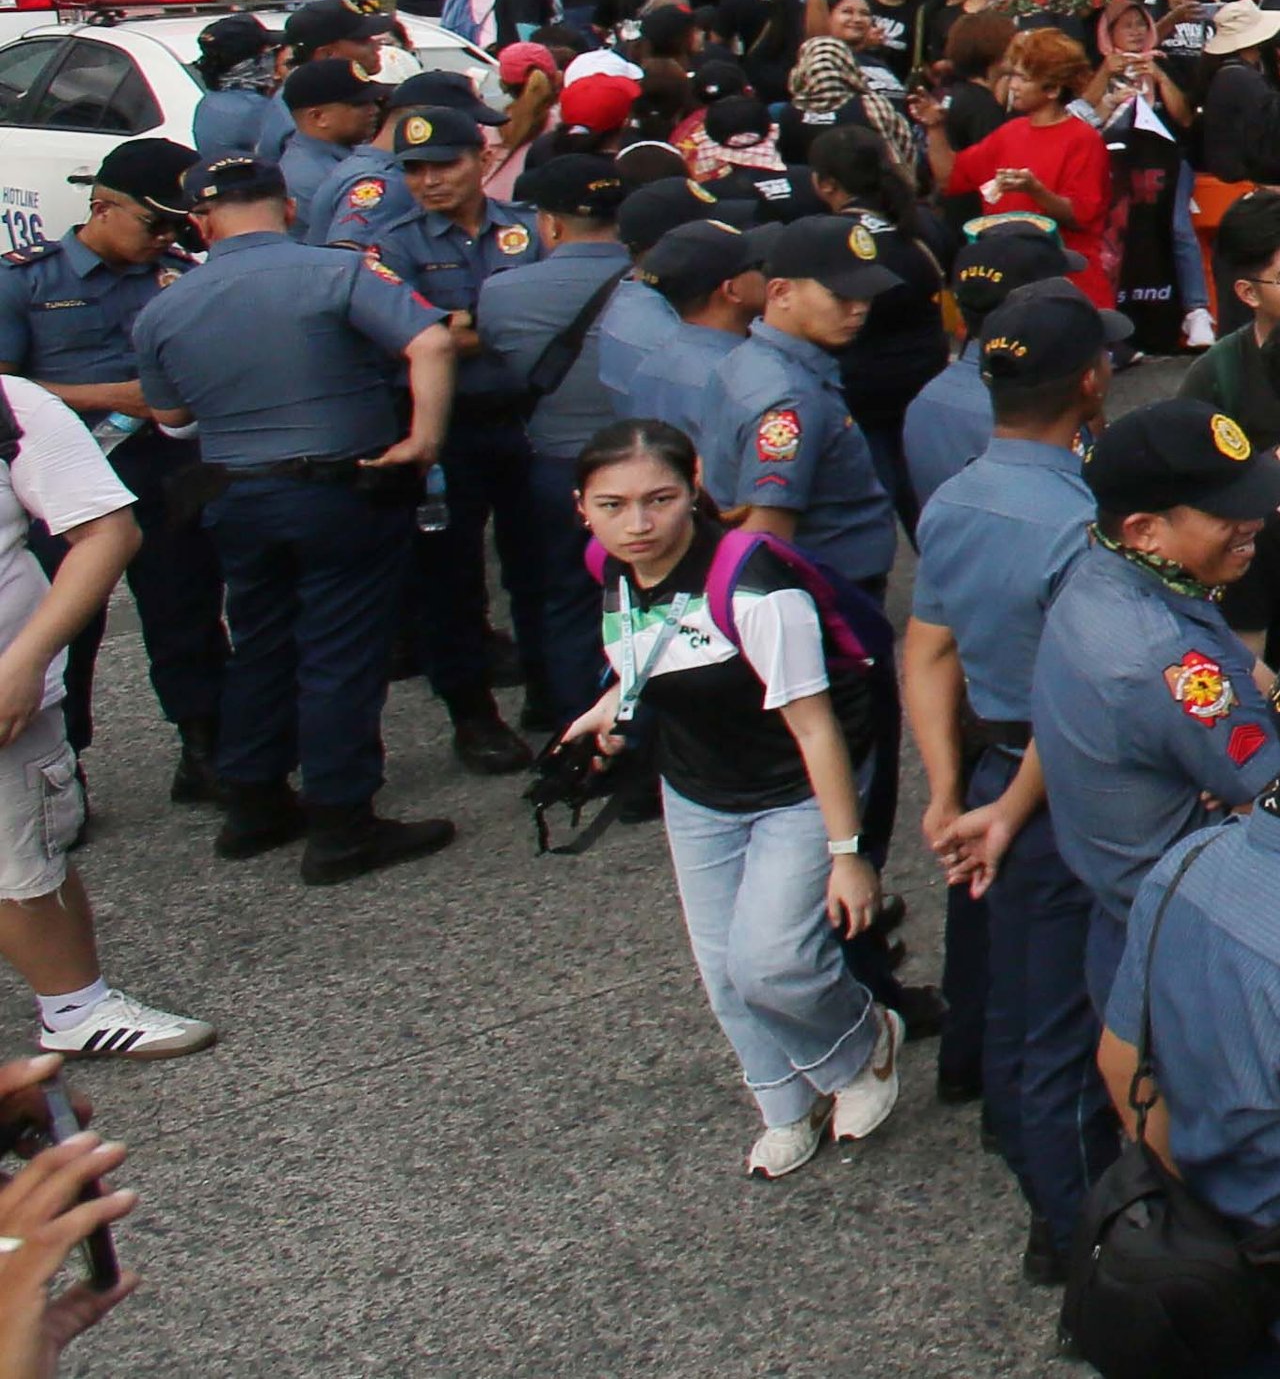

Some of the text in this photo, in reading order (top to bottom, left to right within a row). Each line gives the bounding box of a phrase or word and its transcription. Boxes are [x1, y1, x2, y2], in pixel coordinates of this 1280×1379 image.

[3, 186, 39, 208] HOTLINE
[1, 208, 44, 250] 136
[960, 265, 1003, 283] PULIS
[1132, 285, 1171, 301] and
